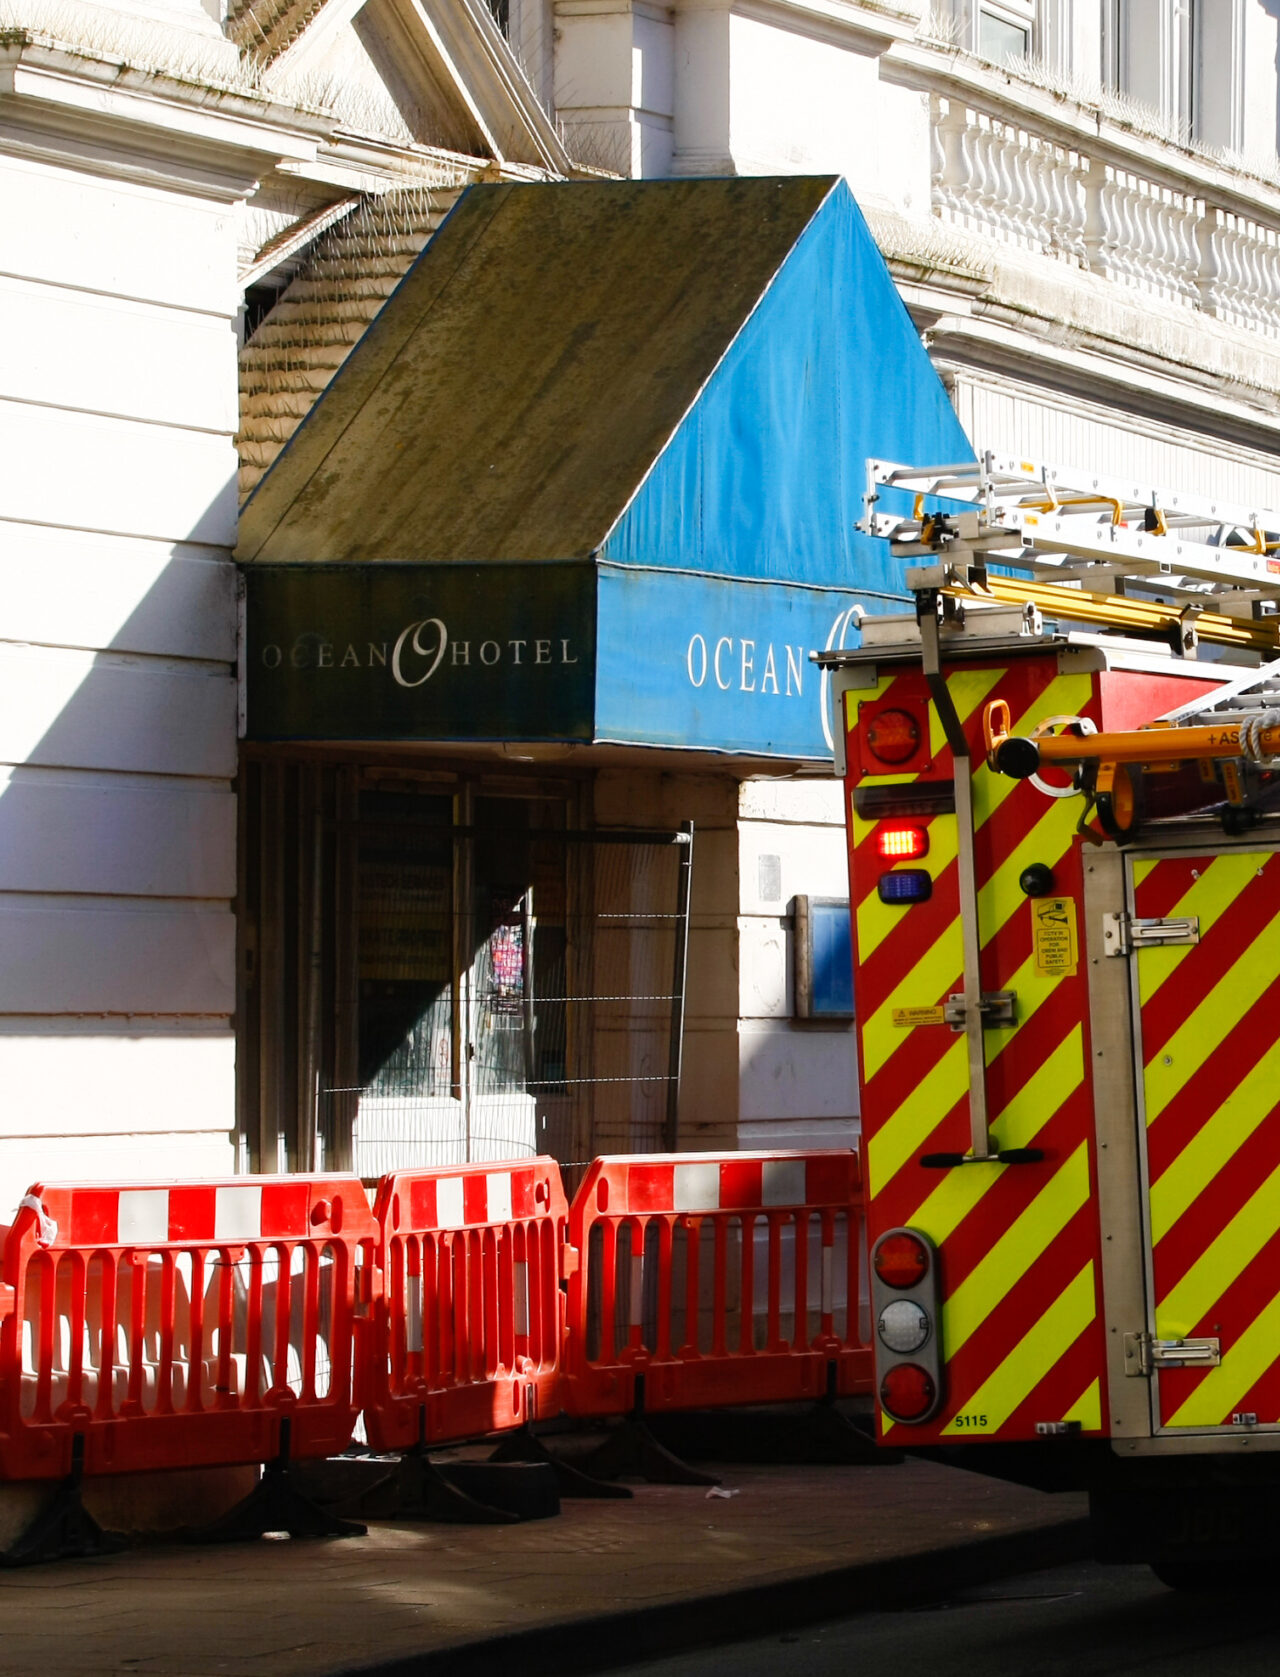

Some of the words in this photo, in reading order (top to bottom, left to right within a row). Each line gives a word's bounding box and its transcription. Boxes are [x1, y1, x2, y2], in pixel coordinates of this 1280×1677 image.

[262, 642, 388, 669] OCEAN
[450, 638, 579, 667] HOTEL
[687, 634, 803, 697] OCEAN
[955, 1415, 987, 1427] 5115
